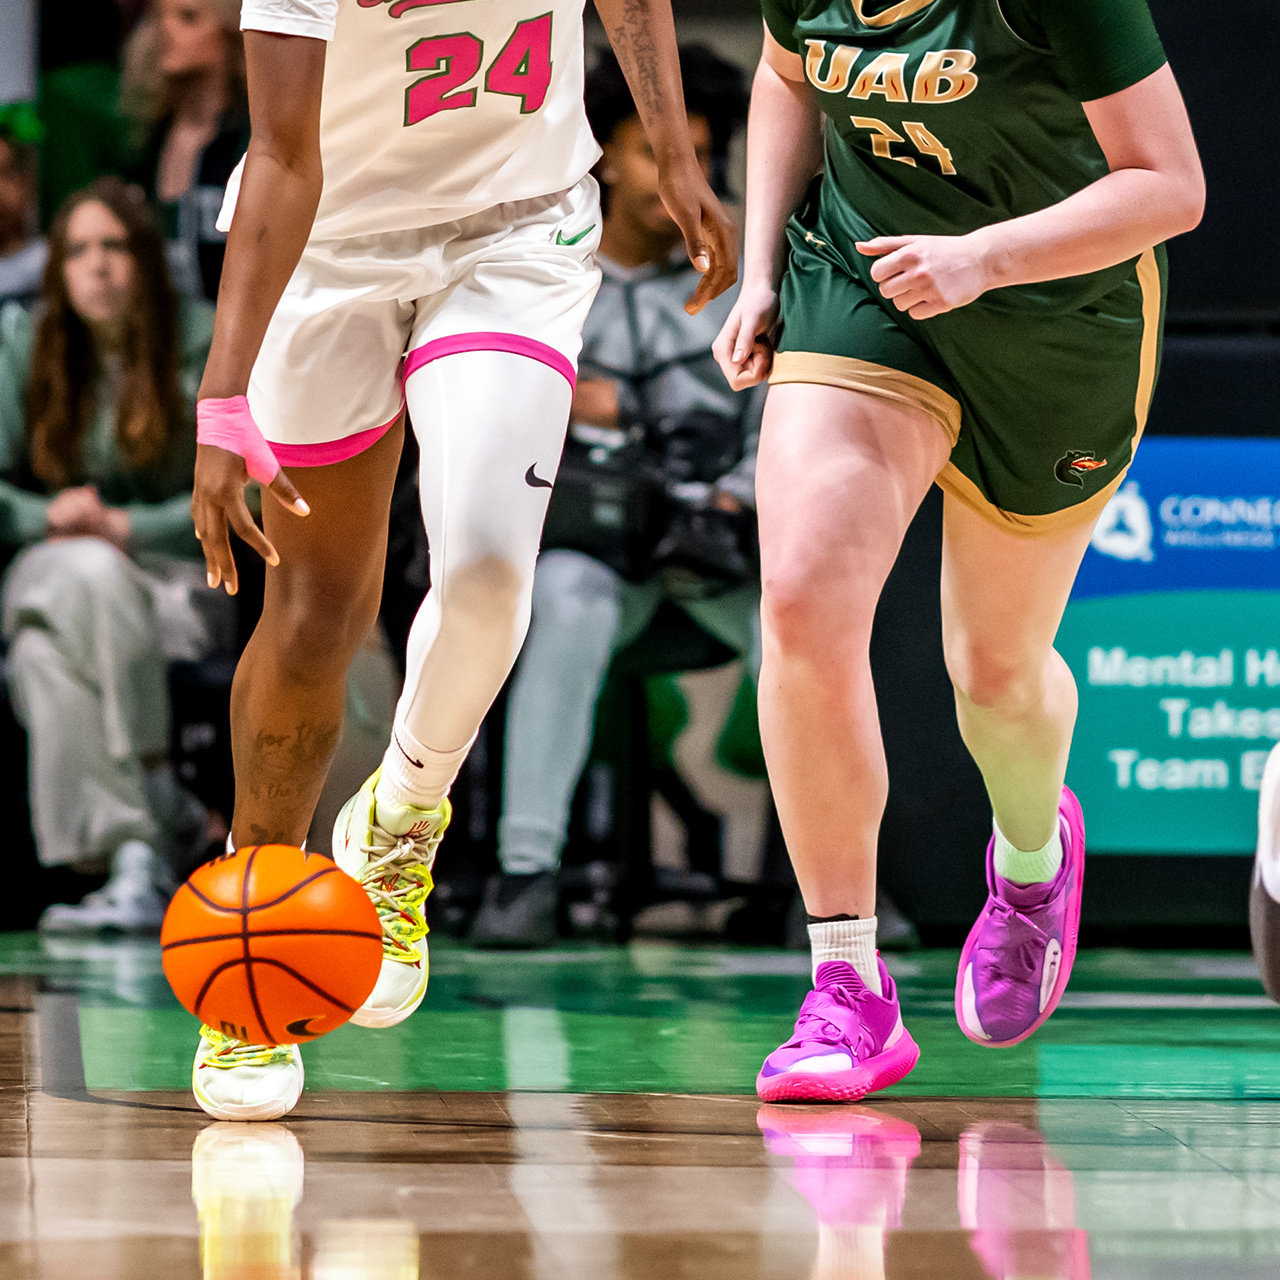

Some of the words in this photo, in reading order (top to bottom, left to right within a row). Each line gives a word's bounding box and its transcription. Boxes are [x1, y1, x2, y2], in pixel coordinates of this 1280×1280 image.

[402, 10, 554, 127] 24
[804, 38, 979, 104] UAB
[849, 115, 958, 176] 24
[1087, 647, 1234, 687] Mental
[1107, 748, 1230, 791] Team
